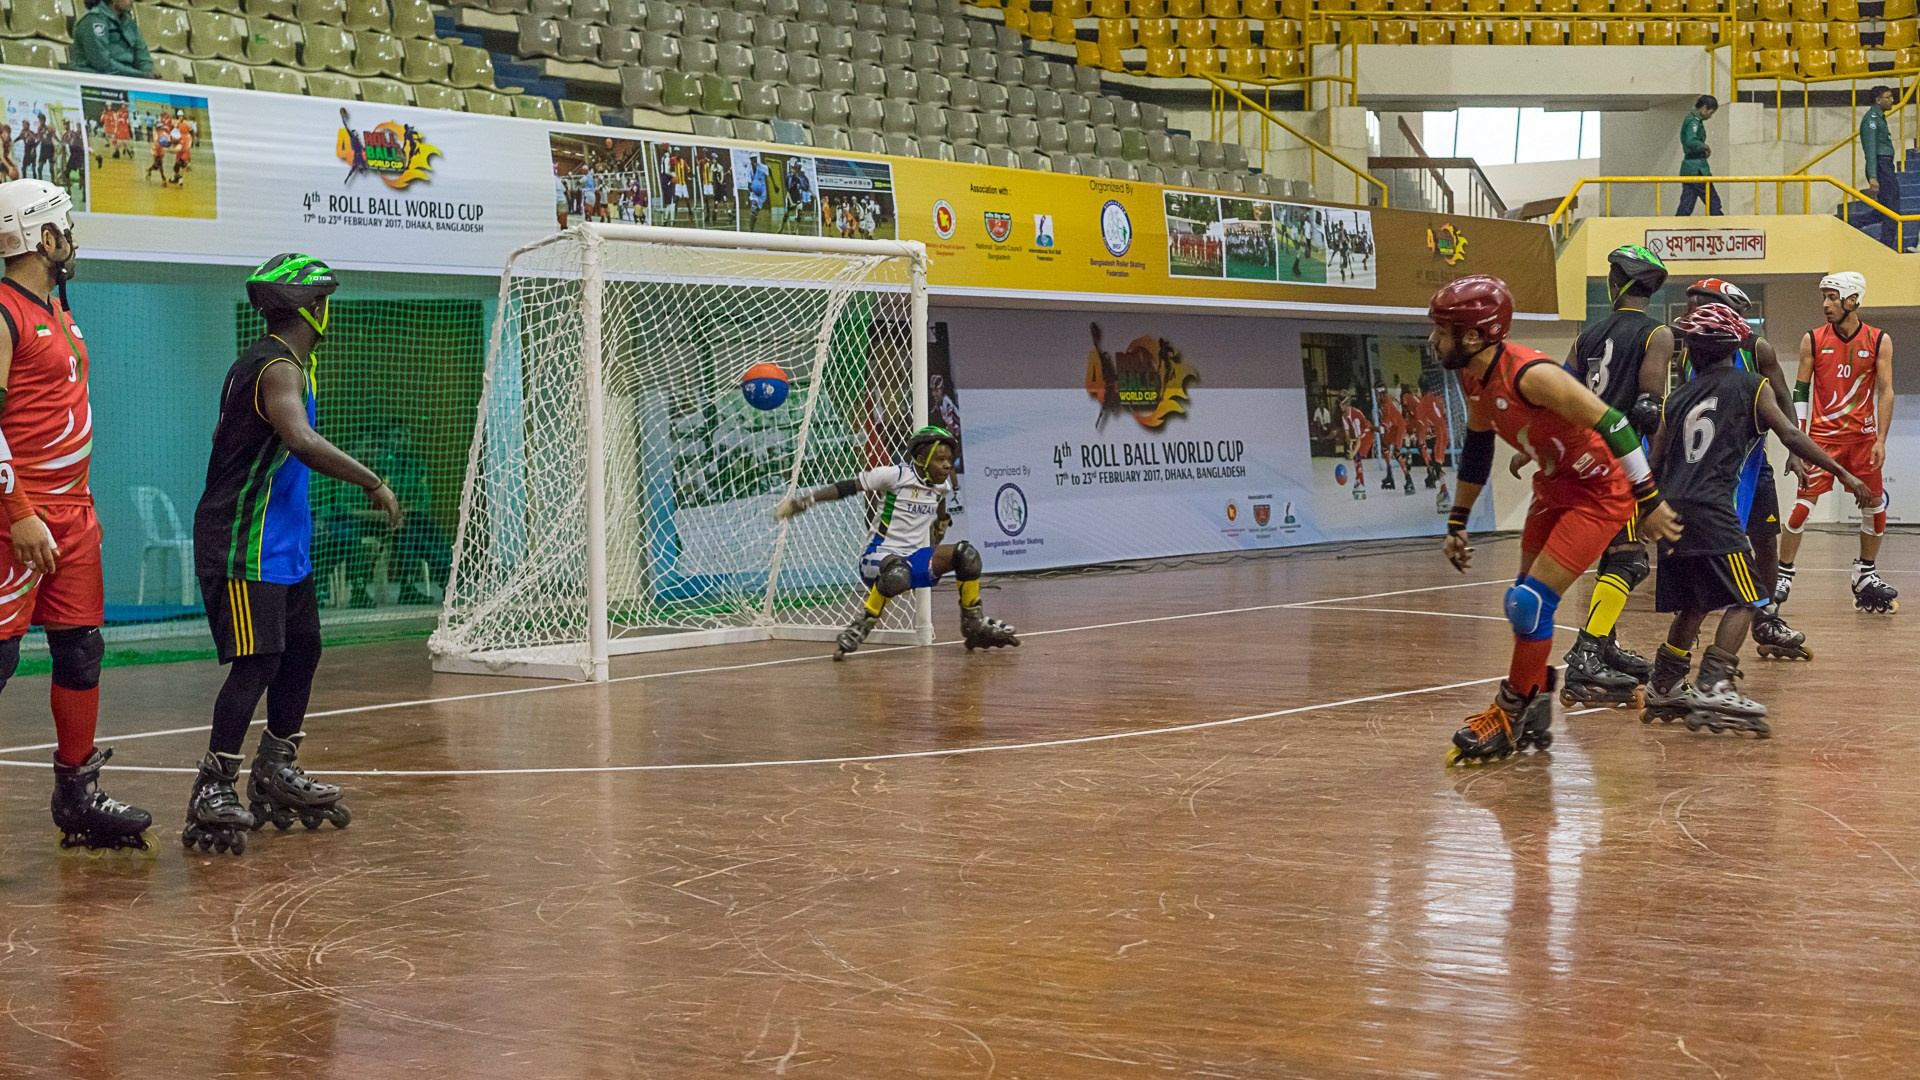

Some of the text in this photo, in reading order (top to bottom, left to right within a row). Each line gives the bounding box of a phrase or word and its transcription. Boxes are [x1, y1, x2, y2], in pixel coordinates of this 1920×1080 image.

[363, 130, 400, 148] ROLL
[365, 145, 401, 161] BALL
[391, 160, 404, 169] CUP
[970, 183, 997, 195] Association
[998, 186, 1008, 196] with
[1089, 180, 1134, 196] Organized By
[303, 190, 484, 221] 4th ROLL BALL WORLD CUP
[318, 215, 326, 224] to
[343, 215, 384, 227] FEBRUARY
[384, 218, 404, 230] 2017,
[405, 219, 434, 232] DHAKA,
[436, 221, 484, 233] BANGLADESH
[1090, 258, 1146, 270] Bangladesh Roller Skating
[1106, 269, 1129, 278] Federation
[68, 355, 77, 383] 9
[1837, 363, 1851, 378] 20
[1119, 391, 1158, 401] WORLD CUP
[1682, 396, 1719, 464] 6
[1053, 440, 1244, 469] 4th ROLL BALL WORLD CUP
[984, 465, 1031, 479] Organized By
[1071, 473, 1080, 485] to
[1099, 470, 1141, 484] FEBRUARY
[1143, 468, 1163, 483] 2017,
[1164, 467, 1195, 482] DHAKA,
[1196, 465, 1246, 479] BANGLADESH
[984, 541, 1012, 549] Bangladesh
[1027, 538, 1044, 546] Skating
